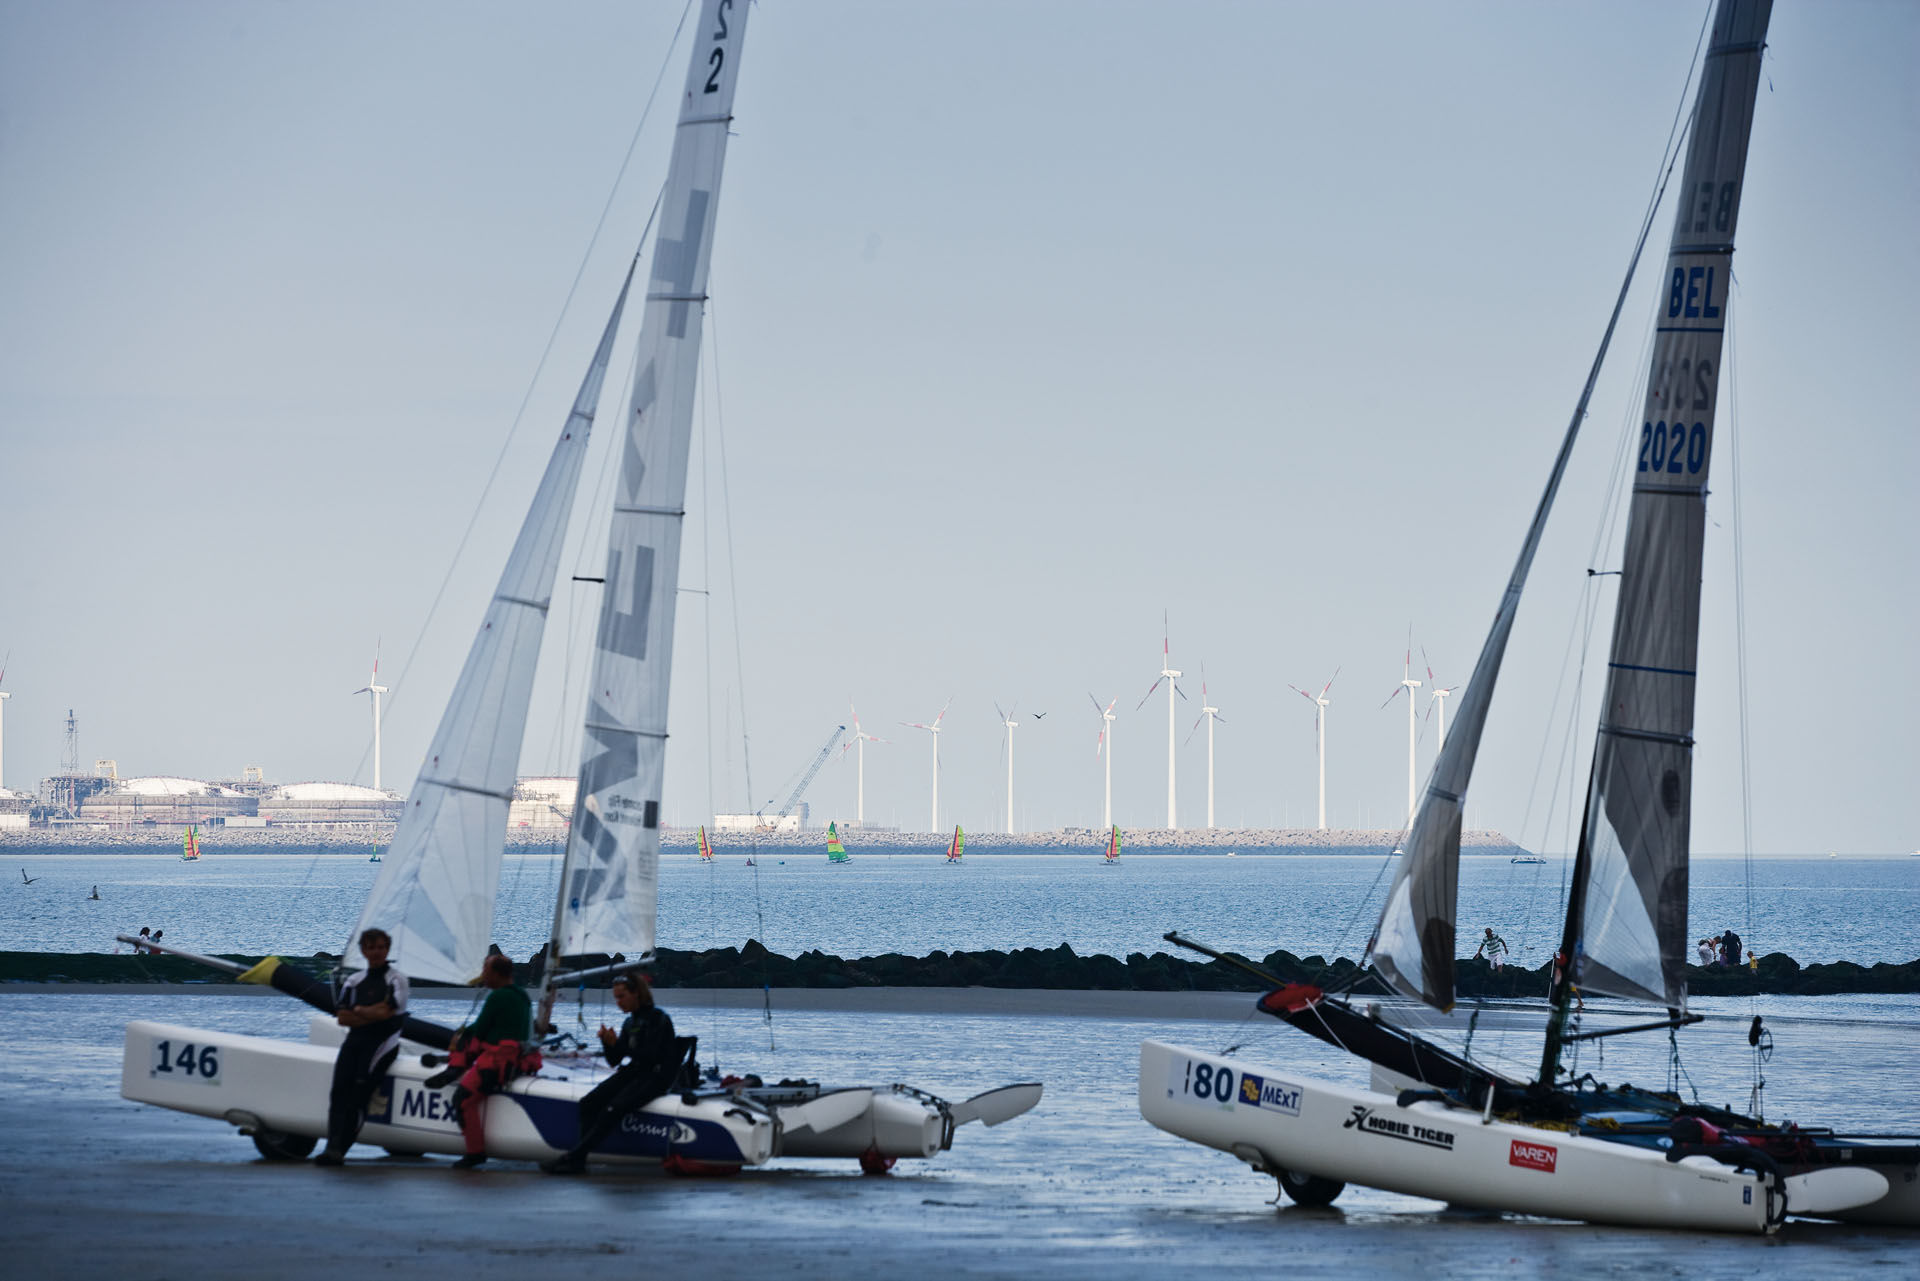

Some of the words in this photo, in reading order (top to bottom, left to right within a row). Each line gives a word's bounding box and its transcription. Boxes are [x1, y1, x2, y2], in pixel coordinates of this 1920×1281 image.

[704, 46, 724, 94] 2
[1668, 266, 1720, 318] BEL
[1638, 420, 1707, 474] 2020
[156, 1040, 218, 1078] 146
[401, 1088, 458, 1122] MEx
[1368, 1116, 1410, 1135] HOBIE
[1412, 1125, 1455, 1145] TIGER
[1512, 1143, 1555, 1164] VAREN
